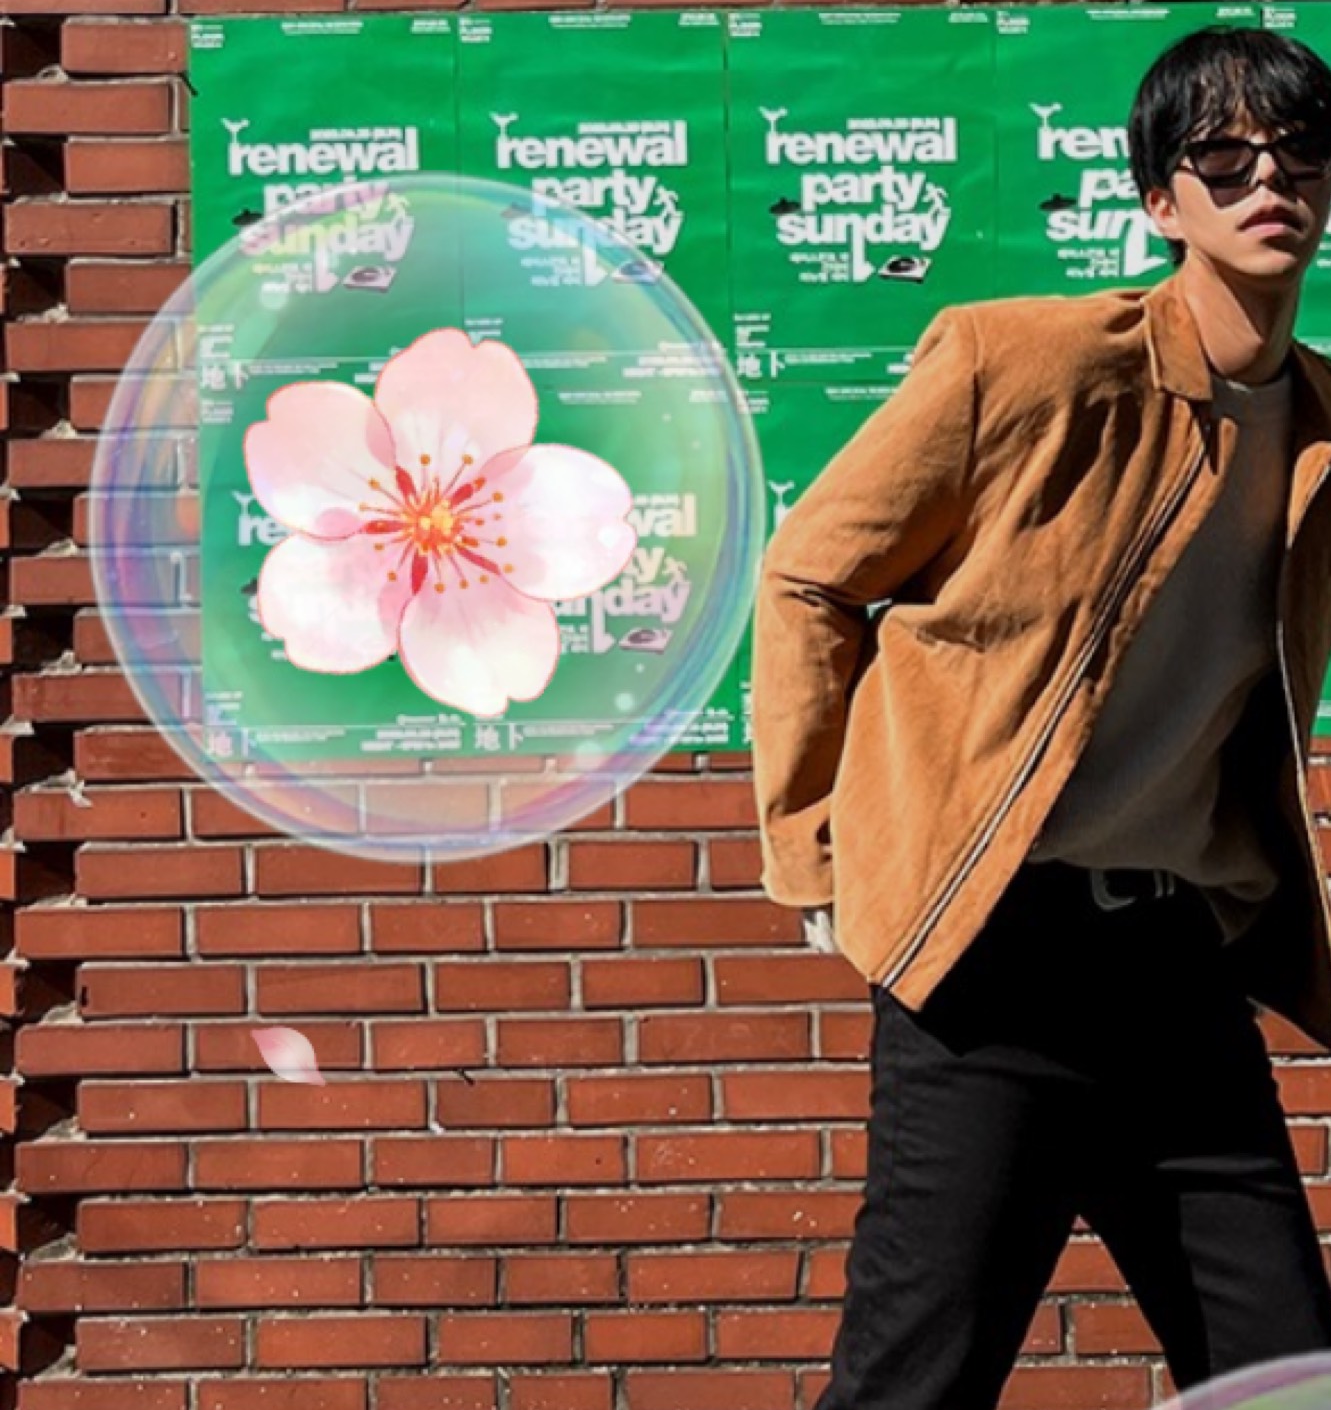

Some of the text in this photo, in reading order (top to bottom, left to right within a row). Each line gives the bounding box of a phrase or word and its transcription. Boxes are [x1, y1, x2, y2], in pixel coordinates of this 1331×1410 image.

[229, 127, 419, 175] renewal
[497, 121, 687, 168] renewal
[766, 118, 957, 164] renewal
[264, 176, 386, 222] party
[532, 170, 656, 216] party
[801, 166, 926, 211] party
[242, 212, 414, 292] sunday
[508, 208, 684, 287] sunday
[777, 204, 951, 281] sunday
